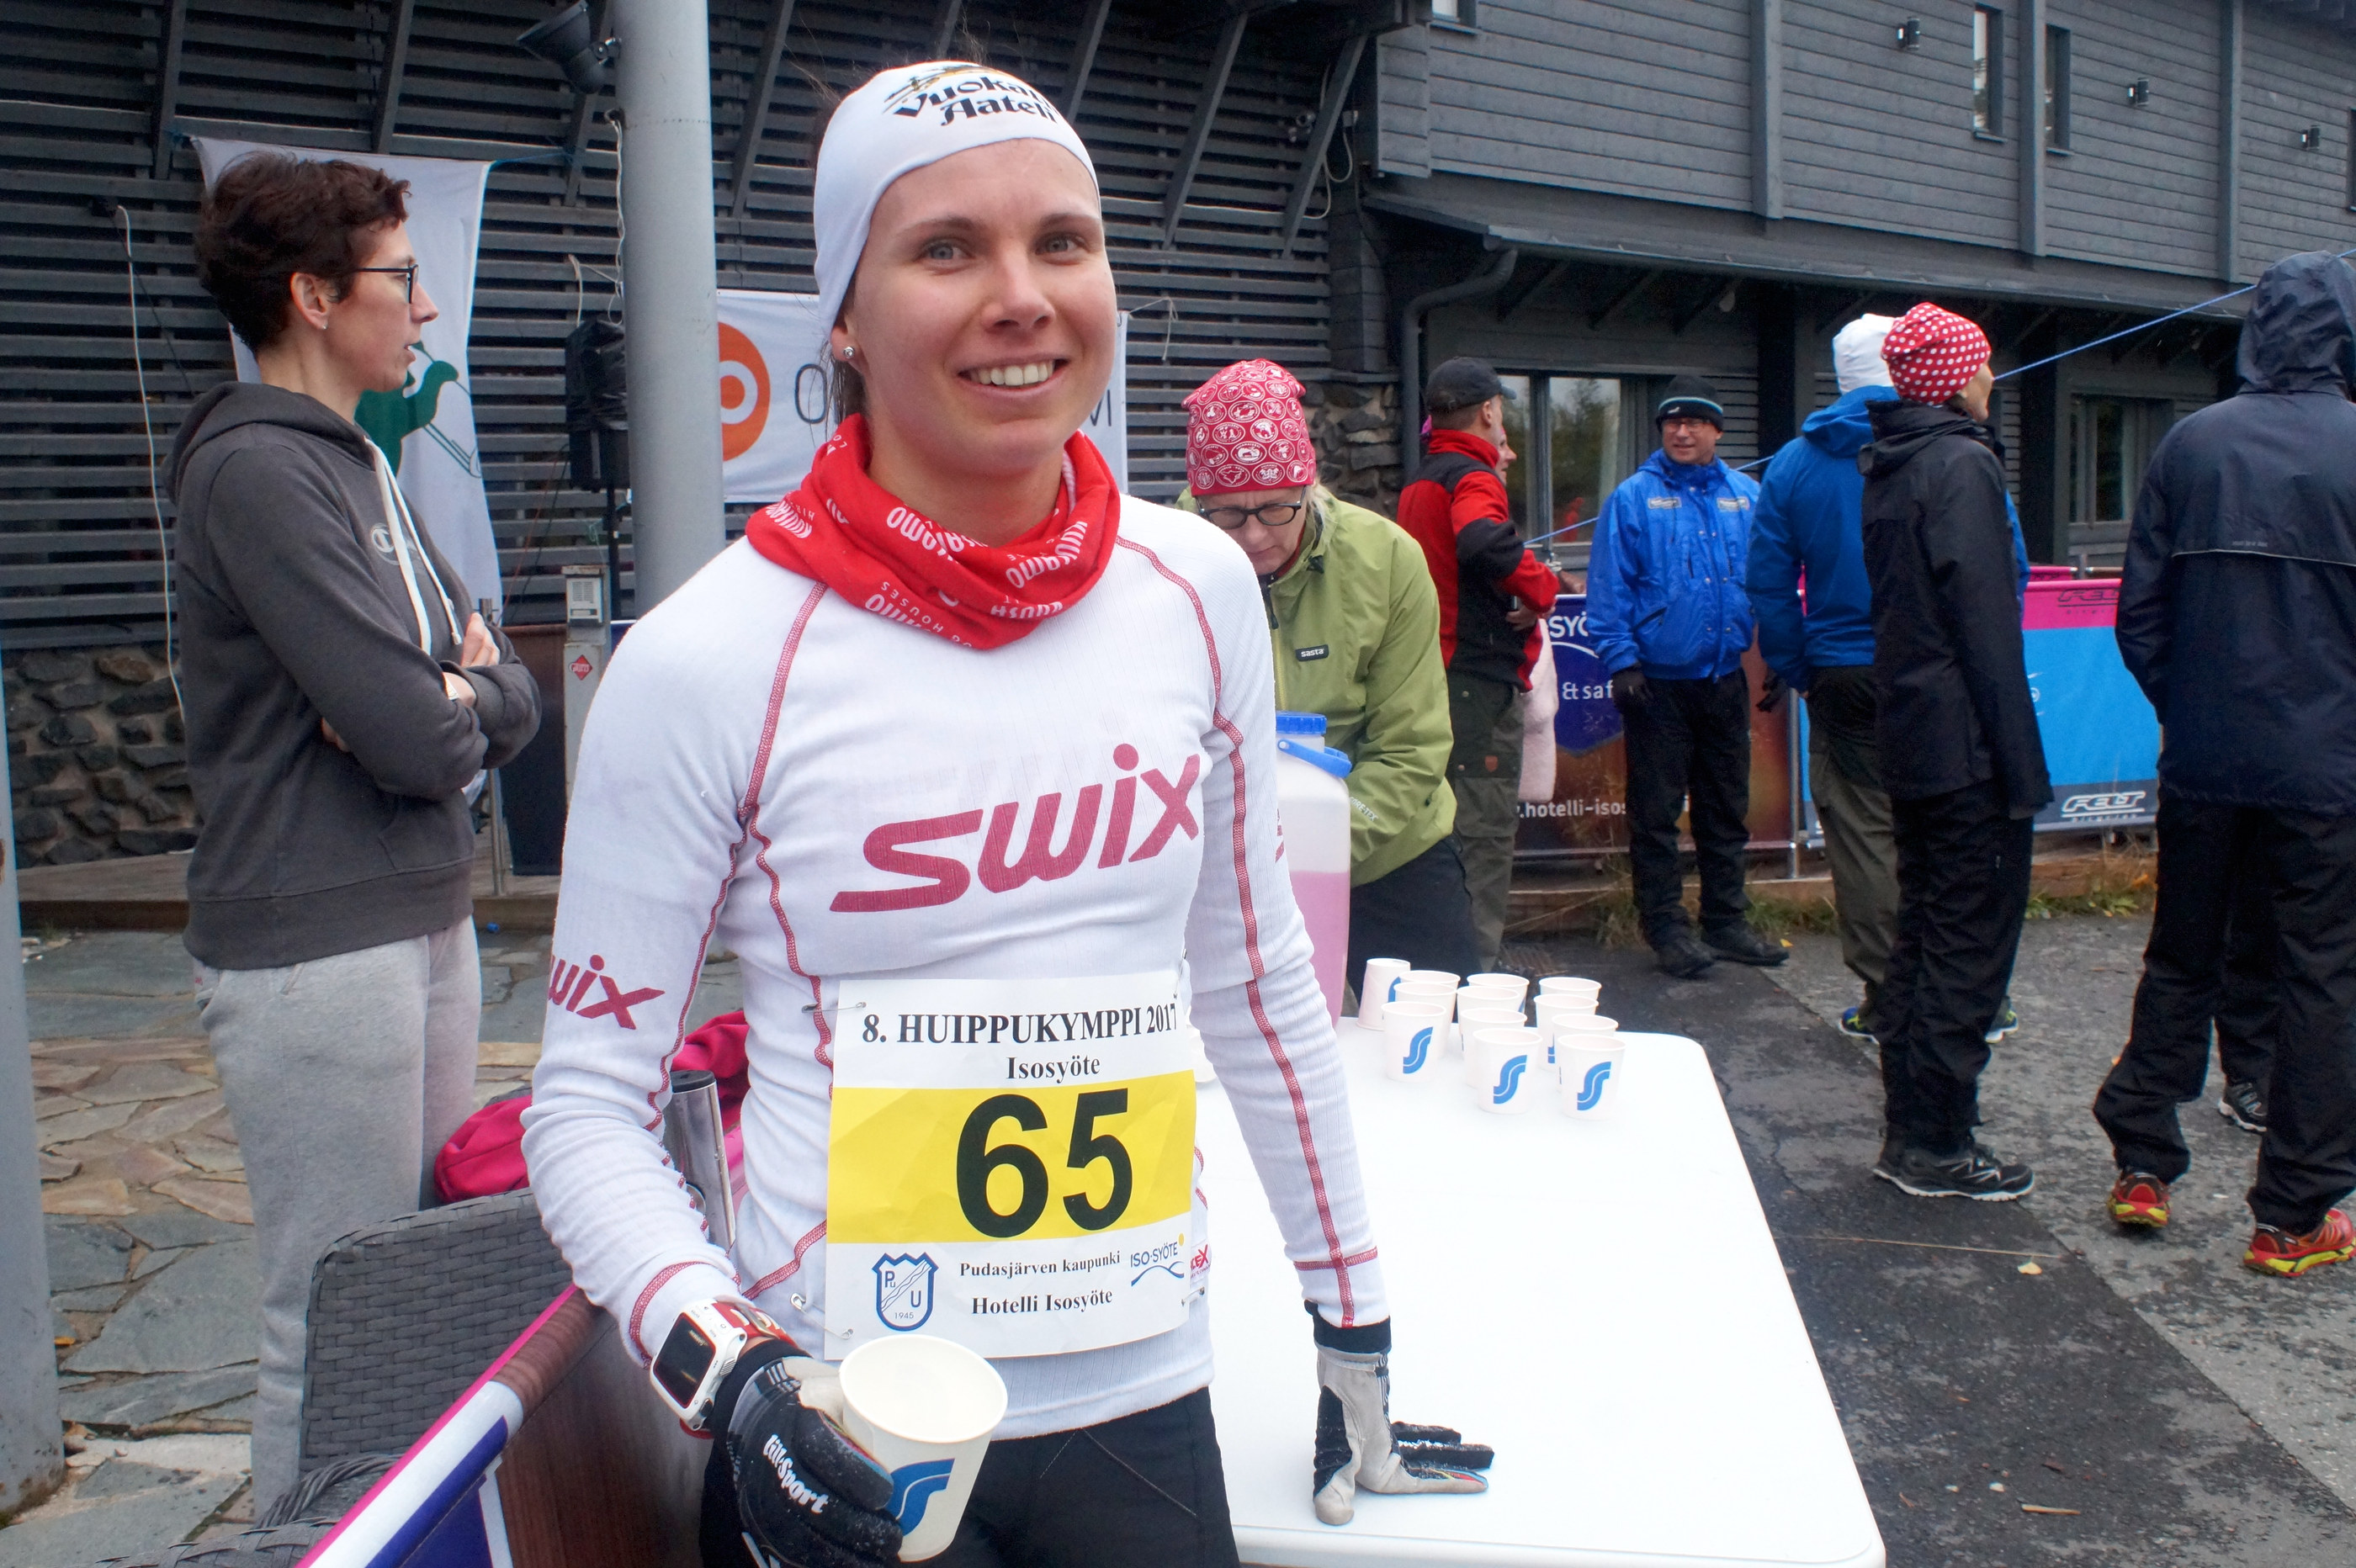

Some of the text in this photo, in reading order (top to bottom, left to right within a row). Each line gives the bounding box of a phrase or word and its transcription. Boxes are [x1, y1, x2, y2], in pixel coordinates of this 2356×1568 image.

[880, 580, 945, 633] HOUSES
[862, 1003, 1176, 1044] 8. HUIPPUKYMPPI 2017
[1006, 1054, 1101, 1084] Isosyöte
[956, 1087, 1133, 1239] 65
[959, 1250, 1122, 1279] Pudasjärven kaupunki
[894, 1311, 915, 1320] 1945
[971, 1289, 1113, 1315] Hotelli Isosyöte
